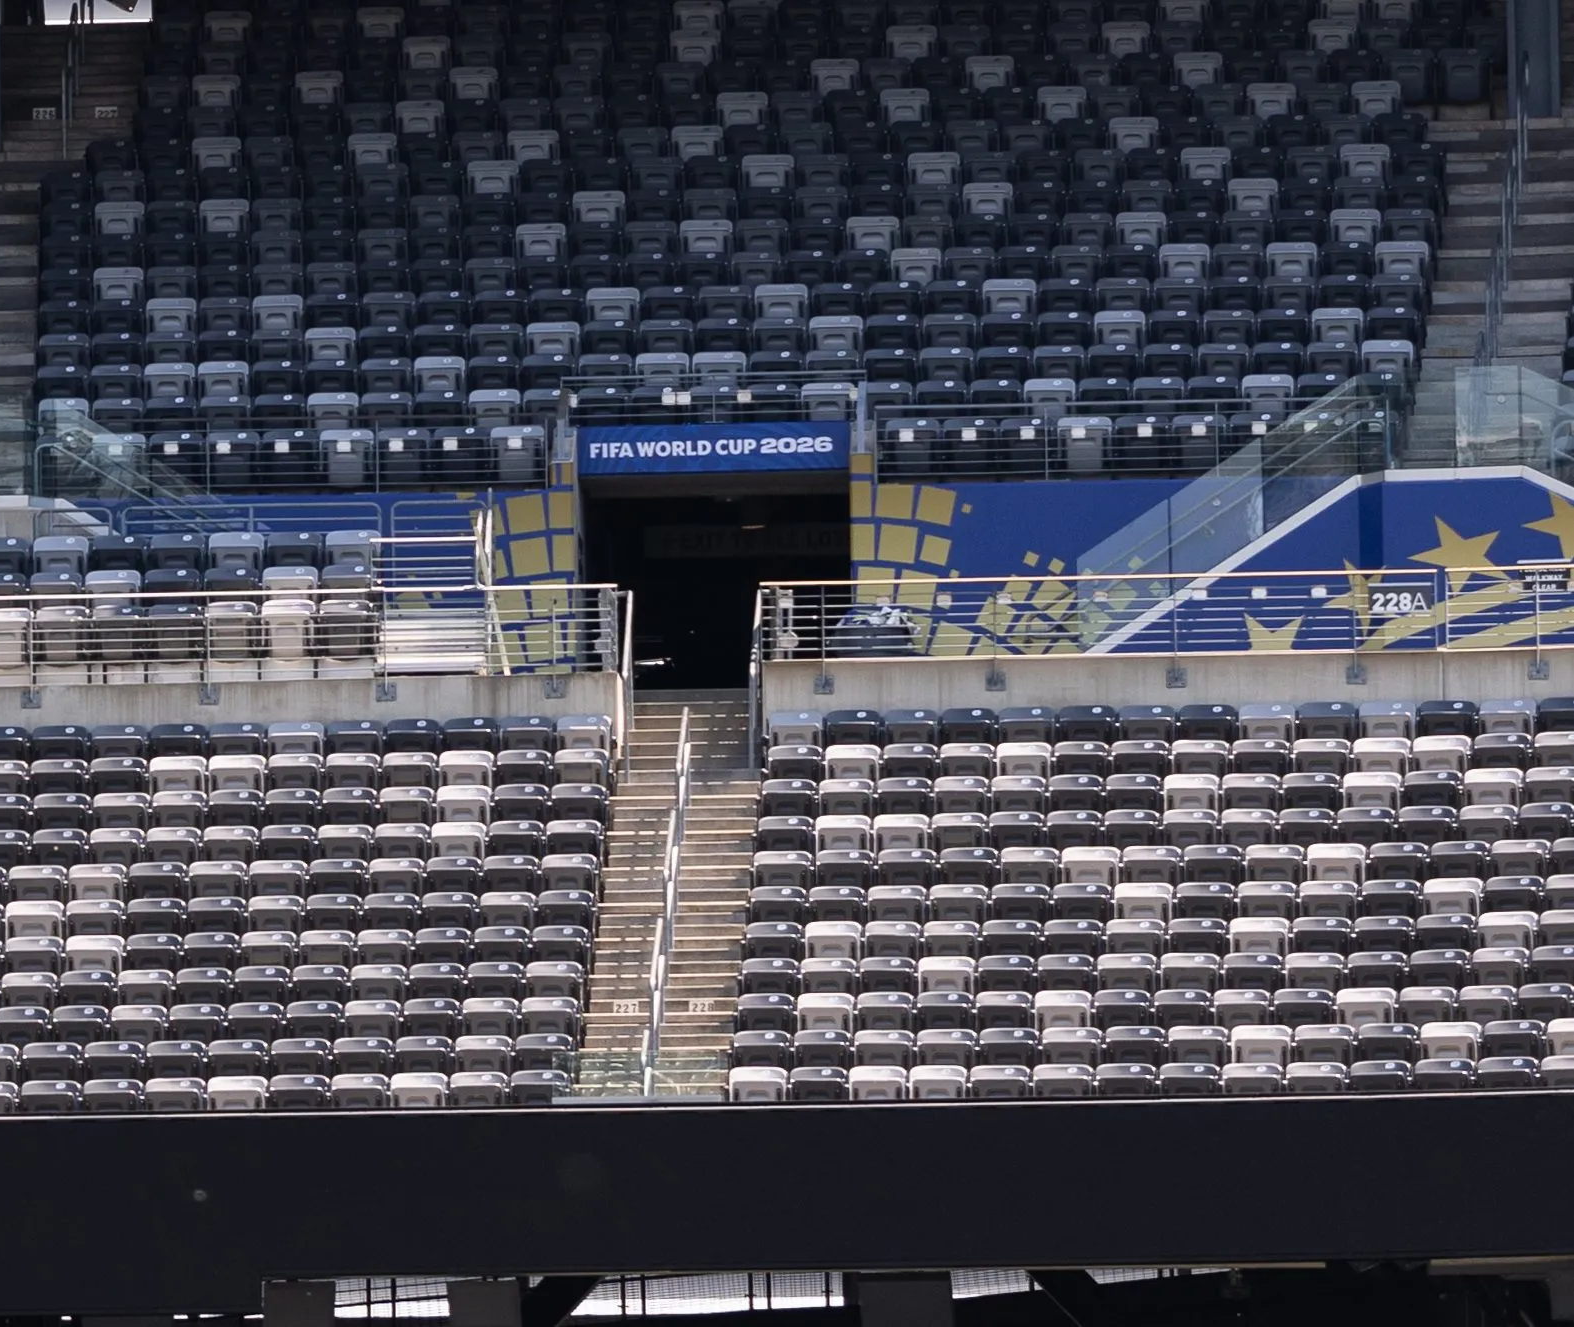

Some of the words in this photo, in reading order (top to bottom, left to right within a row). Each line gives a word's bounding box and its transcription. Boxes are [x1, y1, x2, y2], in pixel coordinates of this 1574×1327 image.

[590, 442, 633, 458] FIFA
[636, 441, 711, 457] WORLD
[715, 439, 757, 455] CUP
[760, 436, 833, 454] 2026
[807, 530, 848, 549] LOT
[1370, 590, 1428, 613] 228A
[615, 1003, 637, 1014] 227
[691, 1002, 715, 1013] 228
